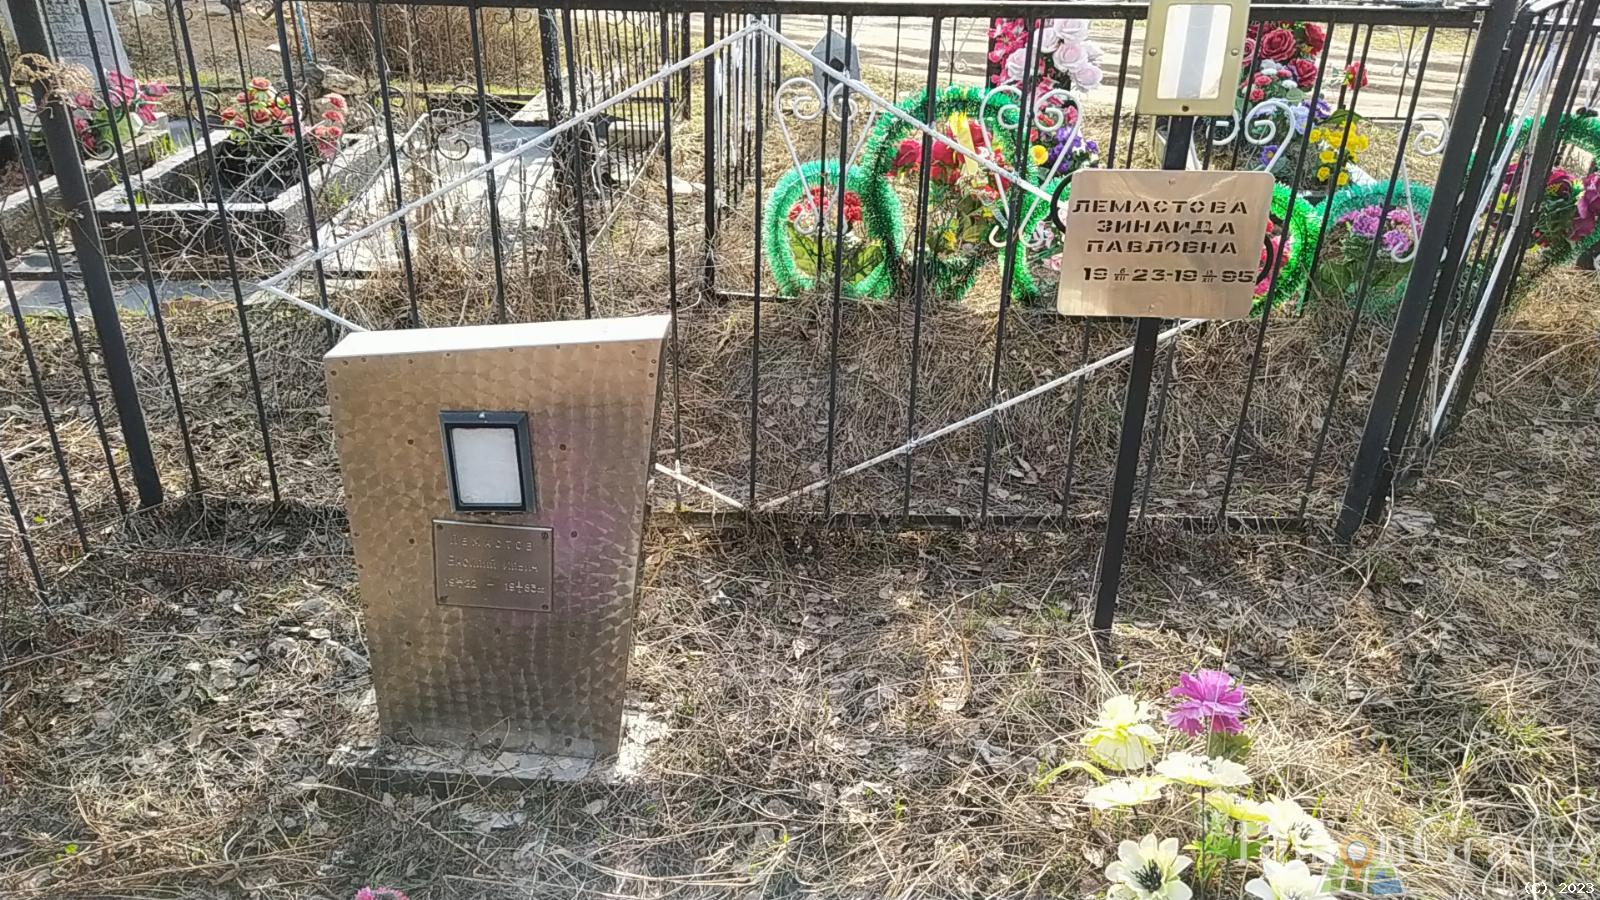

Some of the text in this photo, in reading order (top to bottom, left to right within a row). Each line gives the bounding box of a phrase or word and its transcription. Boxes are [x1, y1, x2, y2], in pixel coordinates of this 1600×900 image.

[1072, 200, 1248, 215] ЛЕМАСТОВА
[1096, 219, 1236, 235] ЗИНАИДА
[1086, 240, 1238, 254] ПАВЛОВНА
